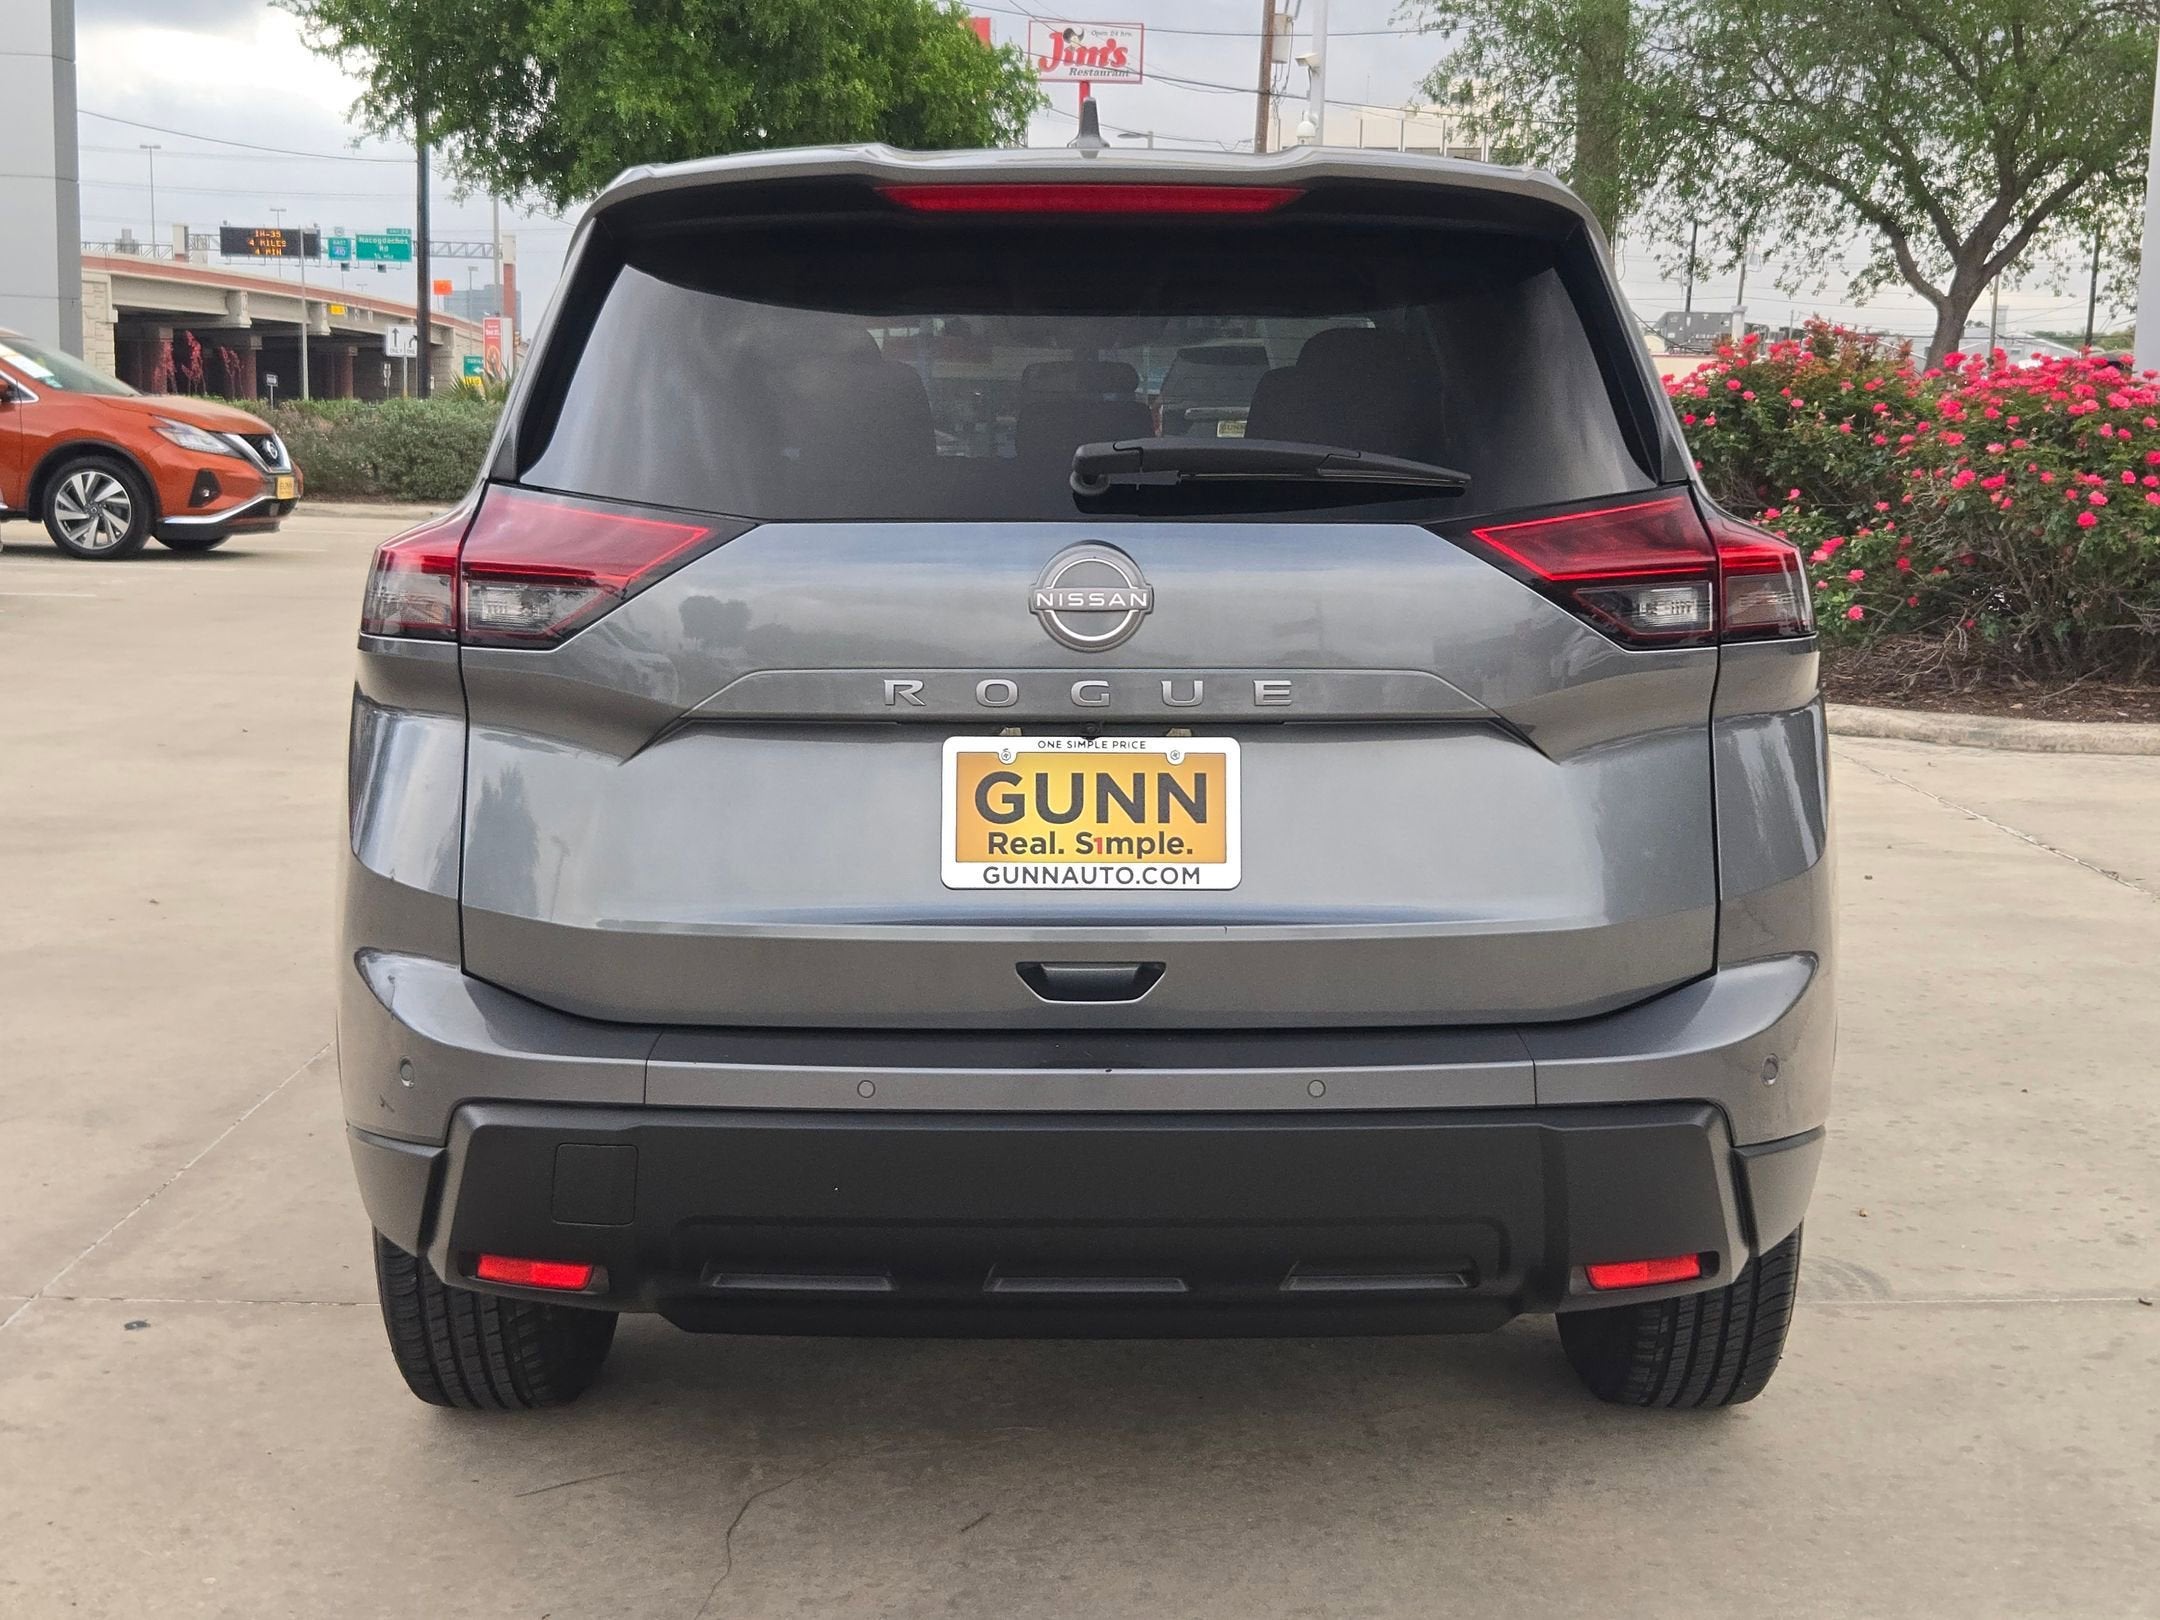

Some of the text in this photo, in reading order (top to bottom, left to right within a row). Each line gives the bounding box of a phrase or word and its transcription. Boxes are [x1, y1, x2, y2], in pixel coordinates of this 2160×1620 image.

[1038, 31, 1128, 72] Jim's
[1068, 67, 1130, 78] Restaurant
[260, 239, 287, 247] MILES
[265, 248, 282, 256] MIN
[1036, 592, 1148, 607] NISSAN
[883, 678, 1293, 707] ROGUE
[1037, 740, 1147, 750] ONE SIMPLE PRICE
[974, 771, 1208, 825] GUNN
[988, 831, 1065, 855] Real.
[983, 865, 1200, 885] GUNNAUTO.COM
